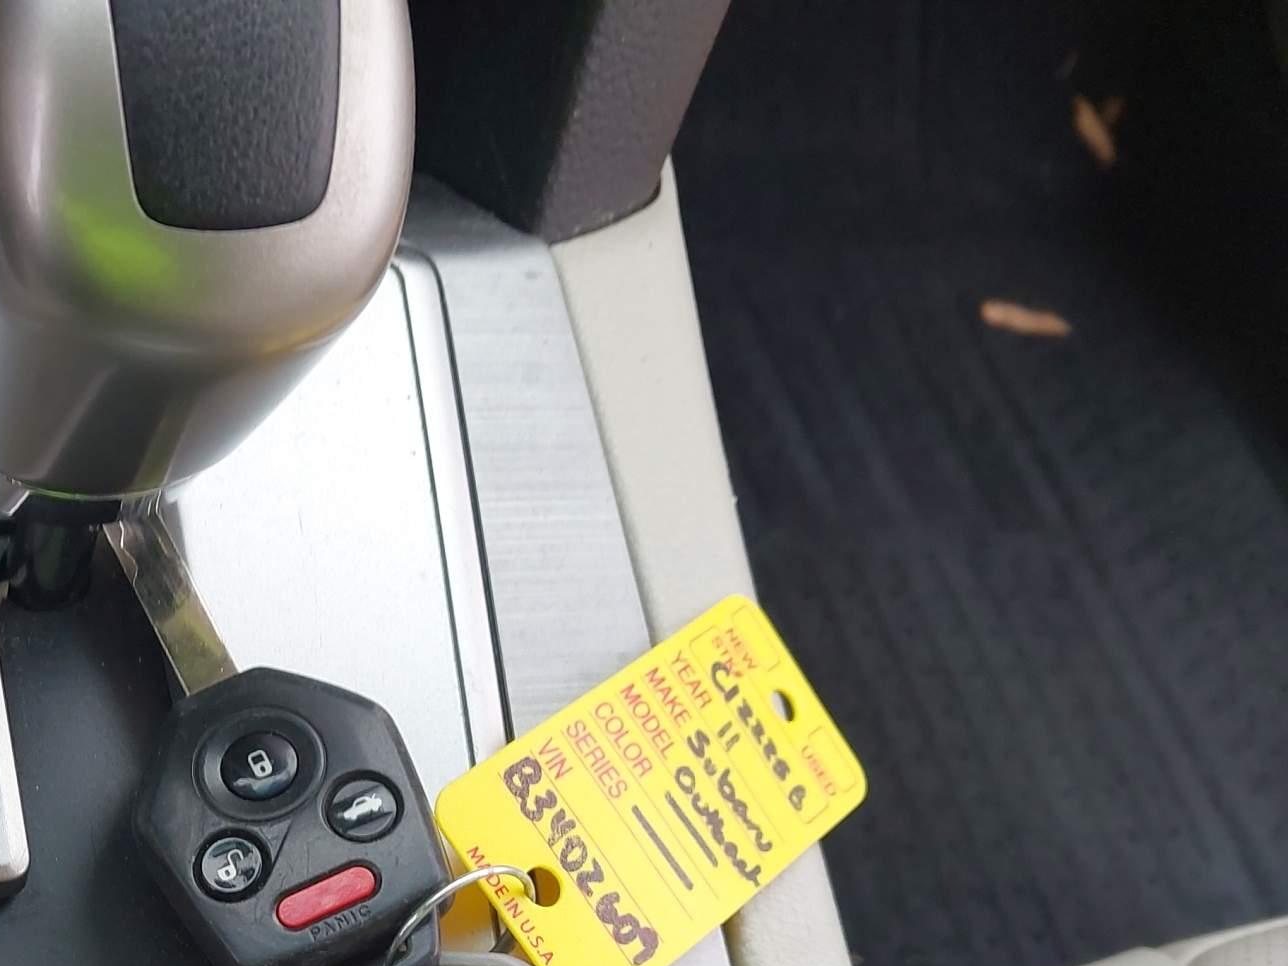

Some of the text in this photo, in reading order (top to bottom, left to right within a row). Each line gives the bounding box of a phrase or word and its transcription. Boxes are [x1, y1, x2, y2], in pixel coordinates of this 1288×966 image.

[725, 628, 757, 670] NEW
[645, 667, 692, 727] MAKE
[672, 651, 712, 709] YEAR
[595, 702, 653, 777] COLOR
[620, 683, 675, 760] MODEL
[539, 737, 573, 780] VIN
[566, 719, 628, 799] SERIES
[802, 745, 836, 796] USED
[467, 846, 508, 899] MADE
[504, 896, 523, 919] IN
[309, 905, 372, 942] PANIC
